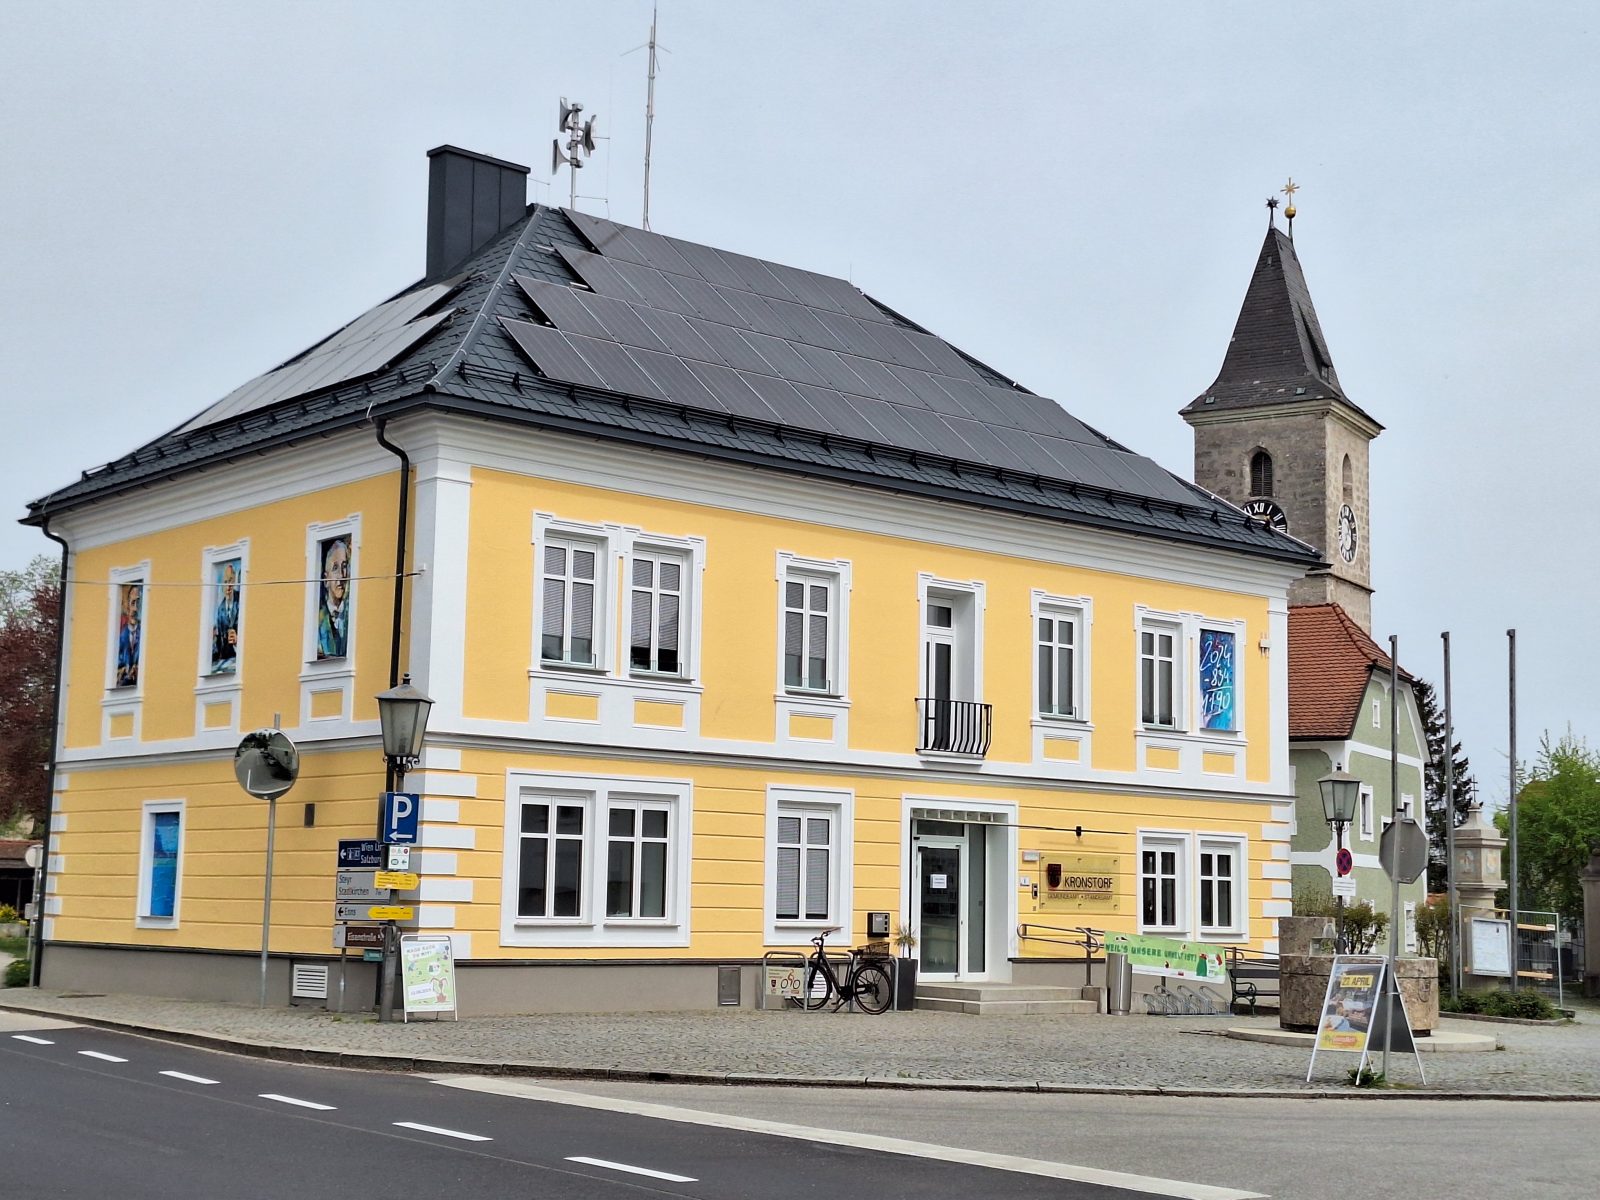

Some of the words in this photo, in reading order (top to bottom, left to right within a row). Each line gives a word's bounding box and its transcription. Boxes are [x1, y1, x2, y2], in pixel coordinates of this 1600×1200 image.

[391, 796, 412, 830] P
[361, 842, 373, 851] Wien
[360, 854, 382, 866] Salzbur
[338, 875, 352, 885] Steyr
[1064, 876, 1113, 889] KRONSTORF
[1131, 946, 1162, 957] UNSERE
[1352, 976, 1370, 986] APRIL
